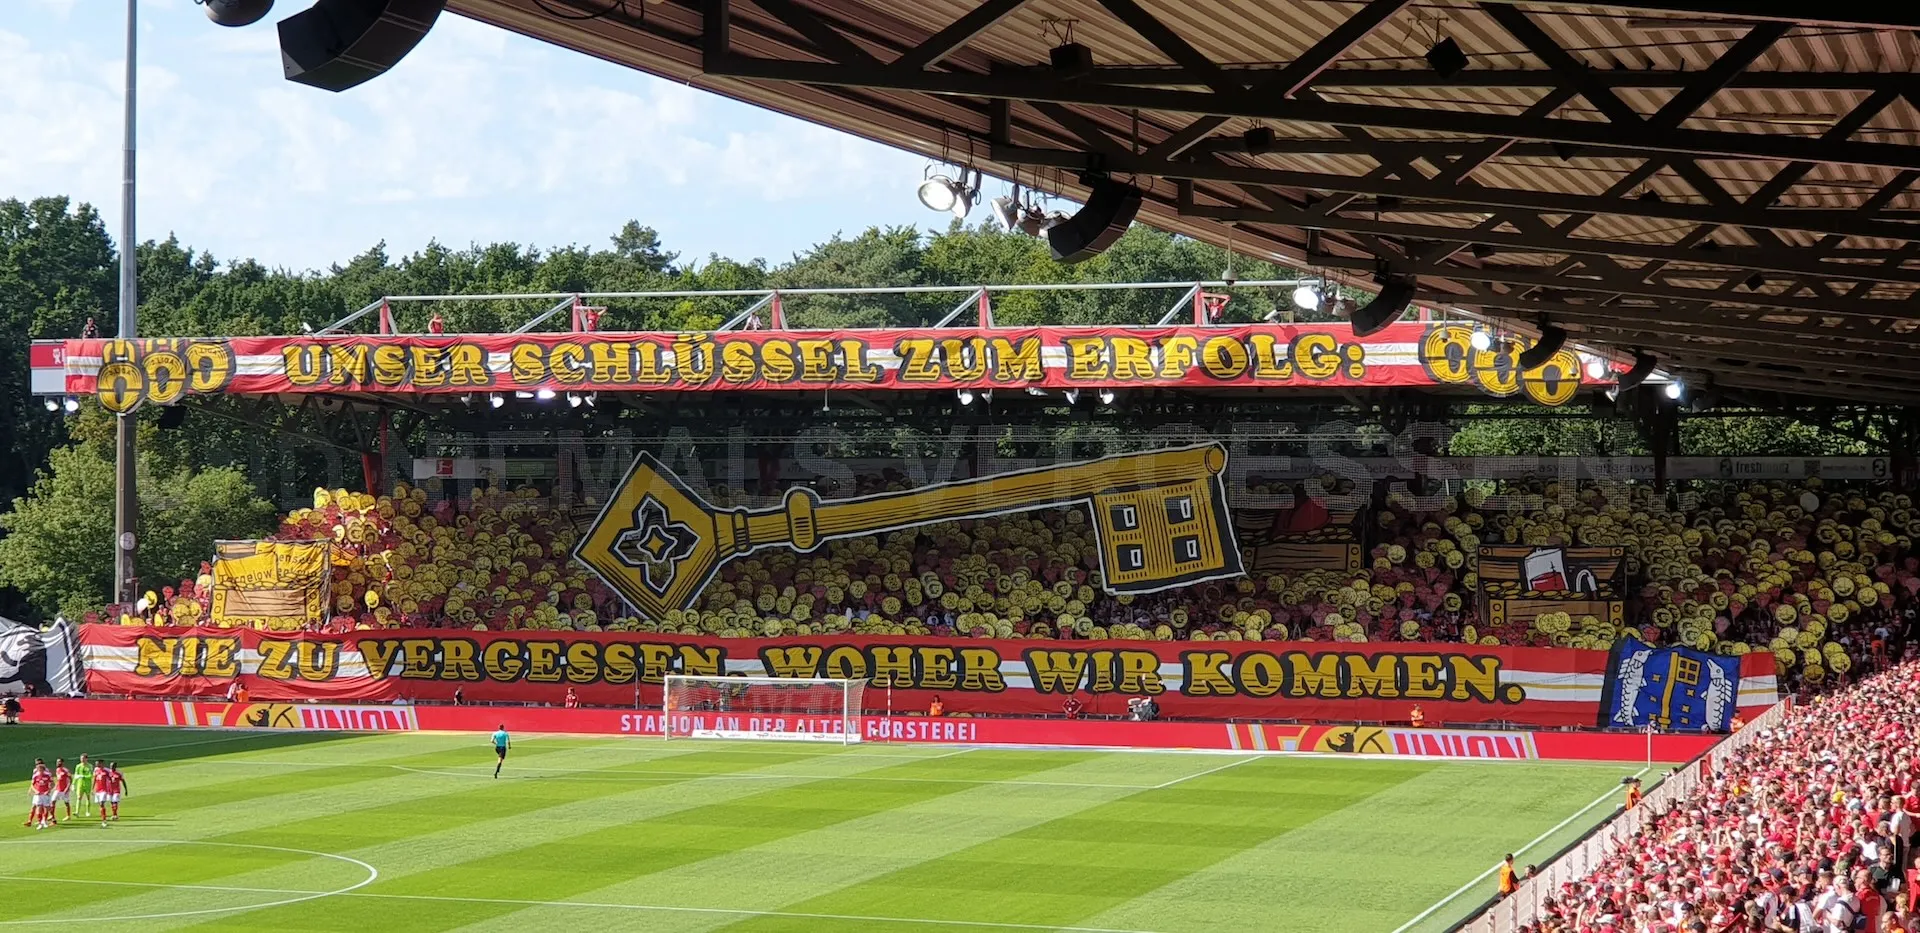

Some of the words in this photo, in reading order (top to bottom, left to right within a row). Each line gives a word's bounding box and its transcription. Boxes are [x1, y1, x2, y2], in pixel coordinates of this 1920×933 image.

[281, 342, 488, 386] UNSER
[510, 332, 879, 384] SCHLÜSSEL
[898, 336, 1043, 382] ZUM
[1064, 332, 1366, 380] ERFOLG:
[136, 636, 240, 677] NIE
[258, 639, 343, 681] ZU
[762, 644, 1006, 692] WOHER
[1027, 649, 1166, 695] WIR
[1186, 652, 1526, 702] KOMMEN.
[621, 714, 704, 733] STADION
[715, 716, 739, 731] AN
[749, 717, 785, 733] DER
[796, 718, 857, 734] ALTEN
[867, 717, 976, 741] FÖRSTEREI
